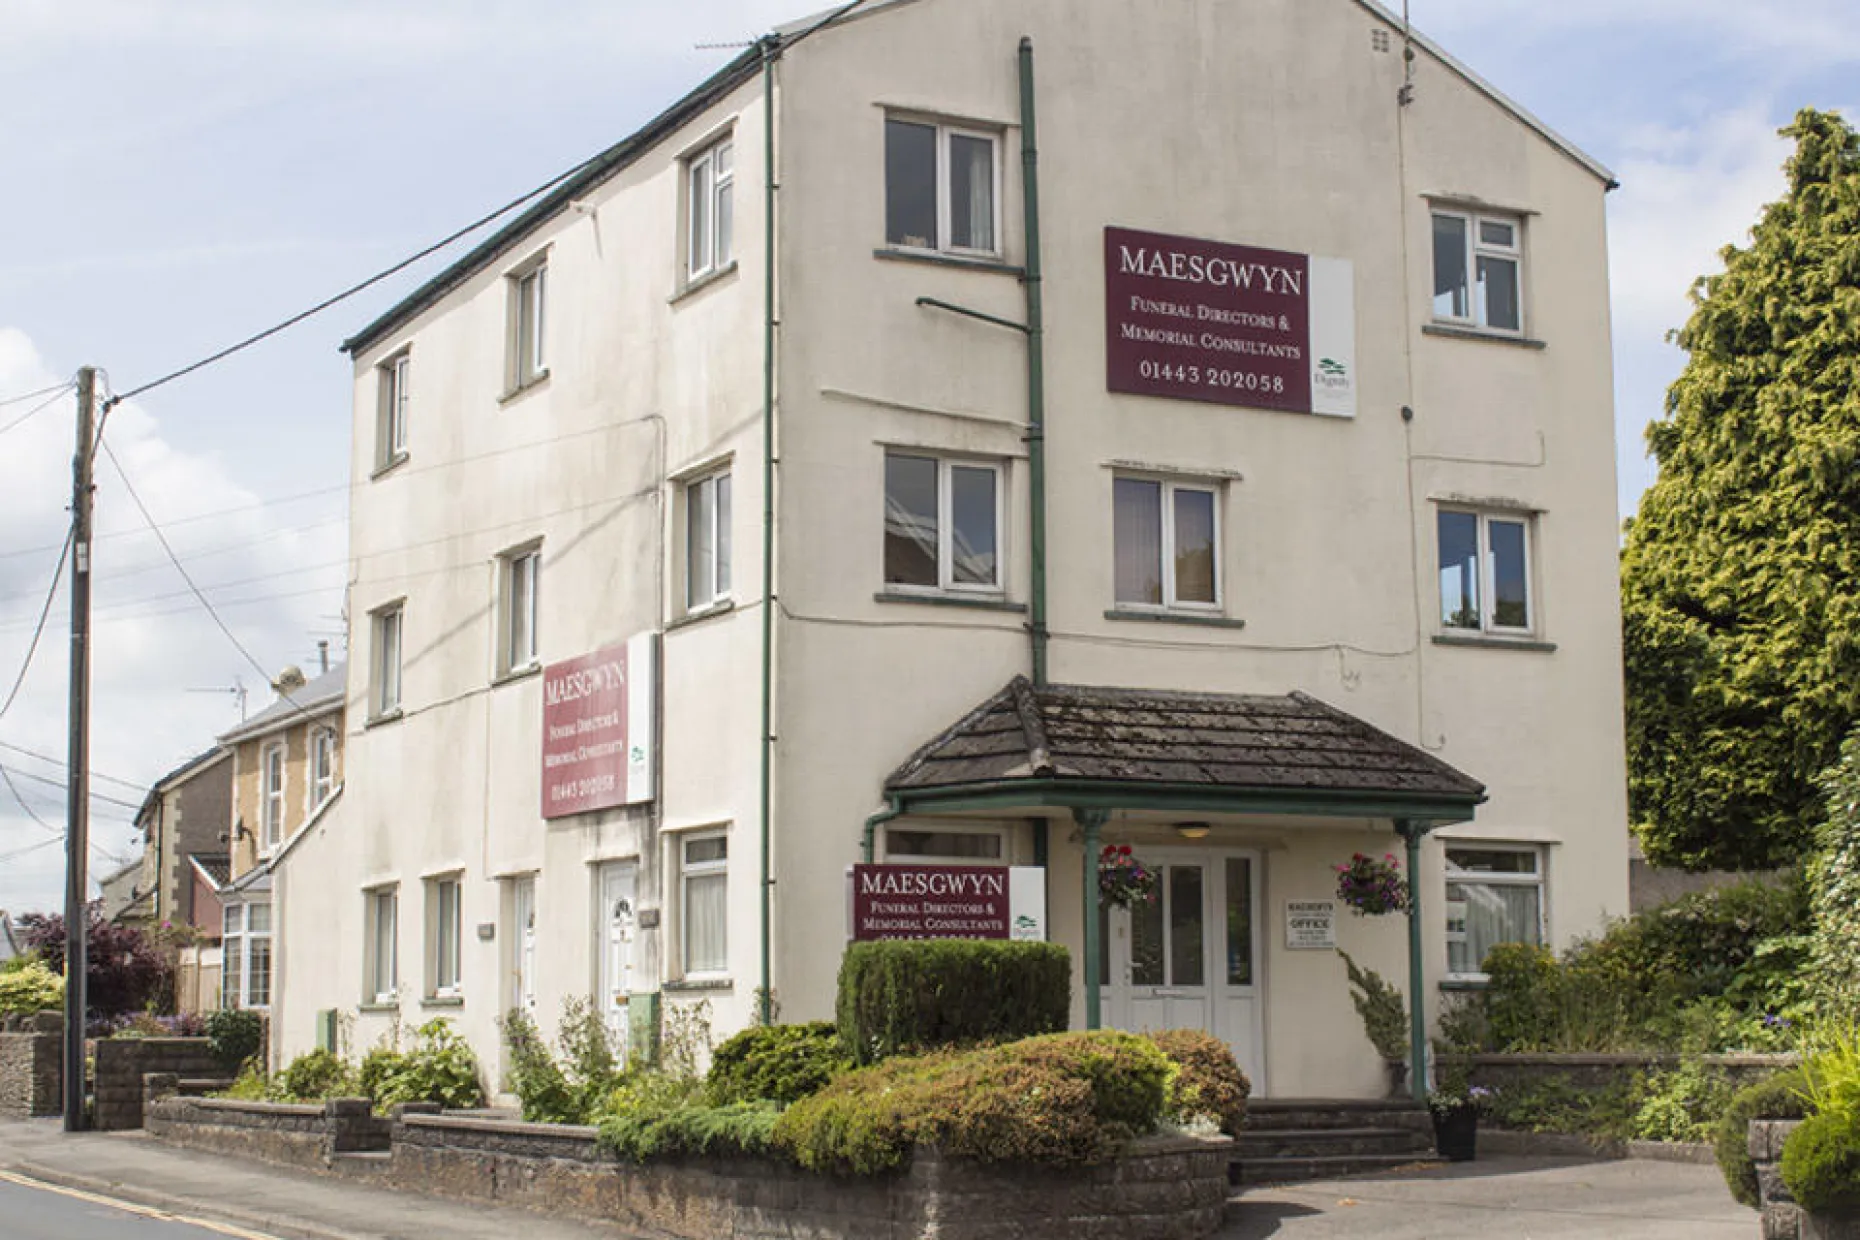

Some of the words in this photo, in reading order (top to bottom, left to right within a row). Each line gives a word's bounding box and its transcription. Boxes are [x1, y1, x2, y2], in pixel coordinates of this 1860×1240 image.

[1120, 245, 1302, 295] MAESGWYN
[1131, 296, 1193, 318] FUNERAL
[1197, 304, 1275, 329] DIRECTORS
[1278, 315, 1290, 331] &
[1121, 323, 1197, 346] MEMORIAL
[1200, 333, 1301, 359] CONSULTANTS
[1140, 360, 1200, 384] 01443
[1206, 369, 1284, 393] 202058
[861, 872, 1003, 895] MAESGWYN
[863, 917, 922, 930] MEMORIAL
[925, 917, 1003, 931] CONSULTANTS
[871, 901, 920, 914] FUNERAL
[923, 902, 983, 914] DIRECTORS
